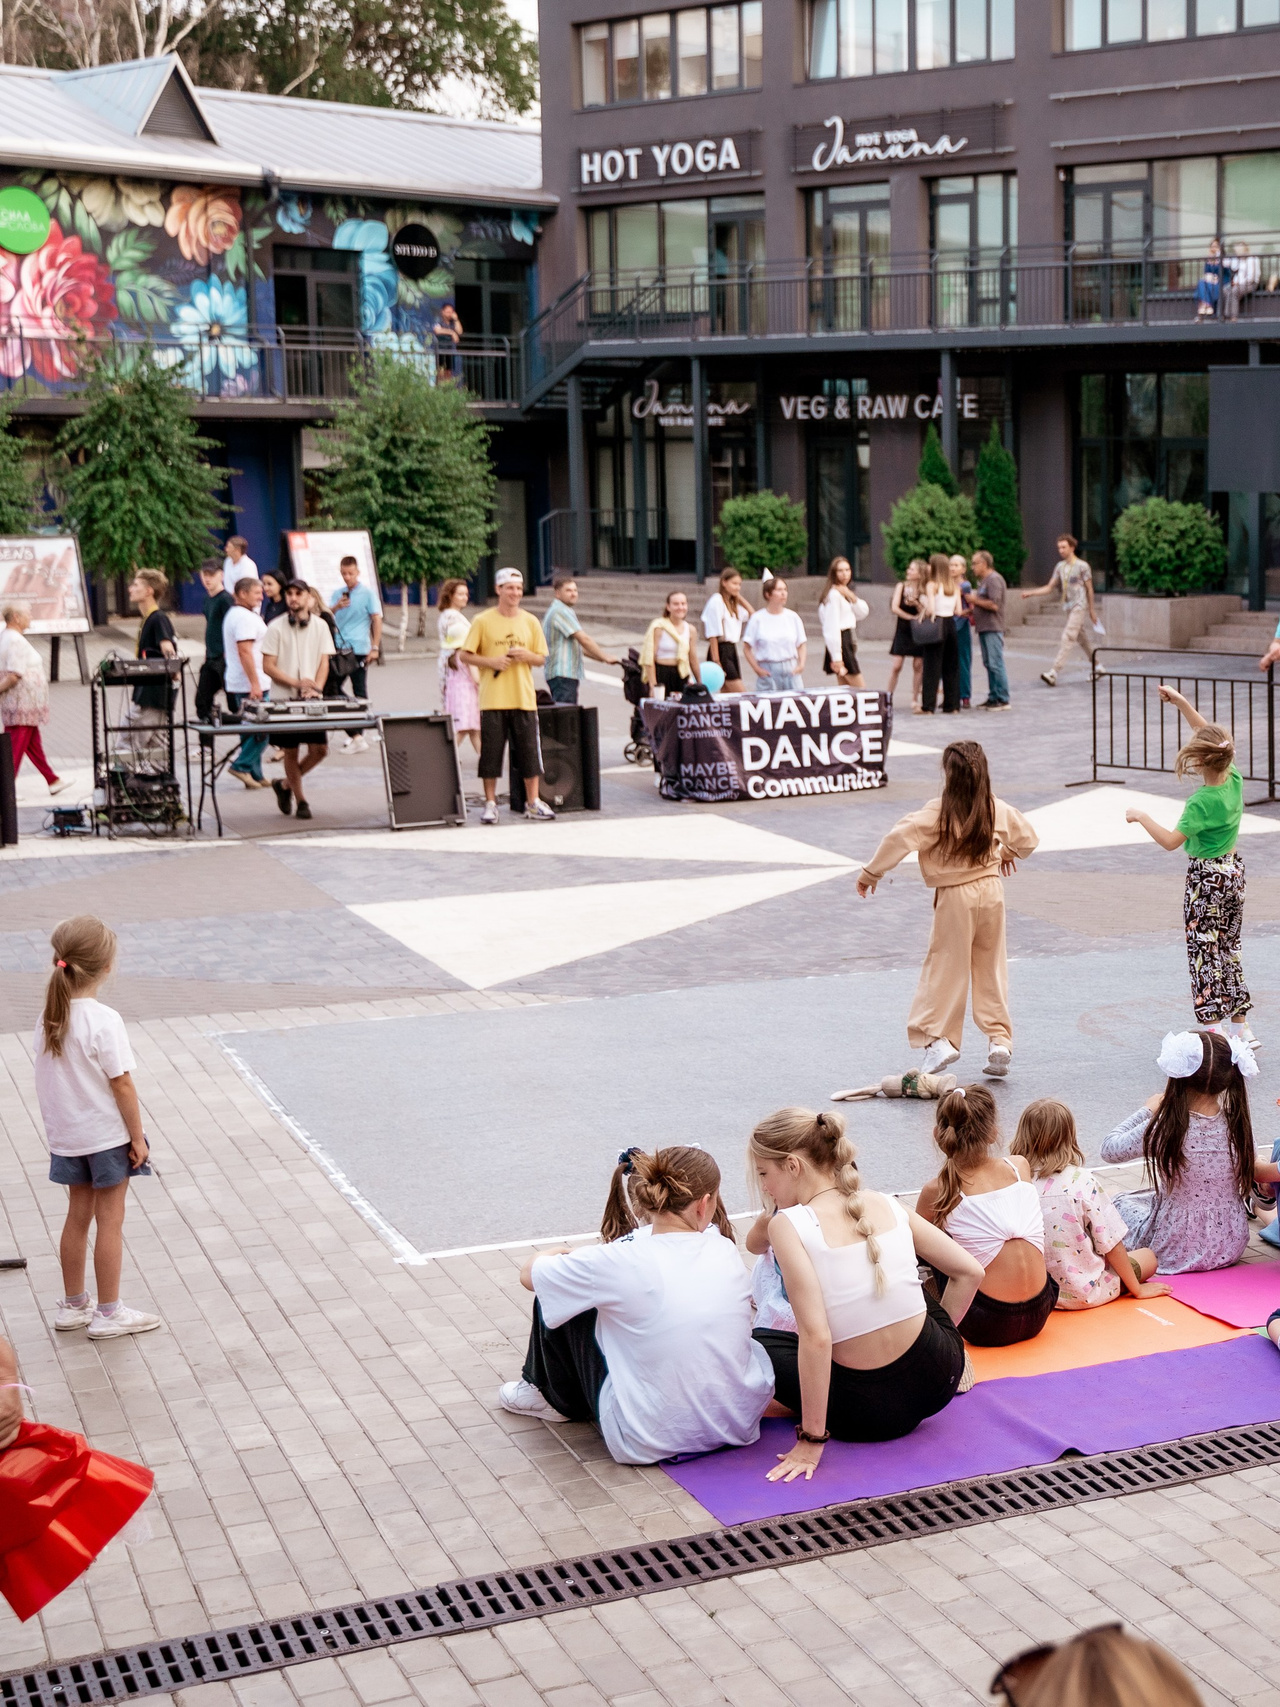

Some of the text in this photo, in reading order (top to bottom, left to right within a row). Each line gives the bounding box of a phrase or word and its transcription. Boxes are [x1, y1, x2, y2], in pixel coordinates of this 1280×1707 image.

[811, 115, 969, 172] Jamuna
[855, 128, 918, 147] HOT YOGA
[580, 137, 741, 185] HOT YOGA
[779, 393, 979, 420] VEG & RAW CAE
[677, 713, 732, 729] DANCE
[739, 691, 883, 731] MAYBE
[678, 728, 733, 739] Community
[741, 729, 884, 771] DANCE
[680, 761, 738, 777] MAYBE
[681, 776, 740, 791] DANCE
[747, 767, 883, 799] Community
